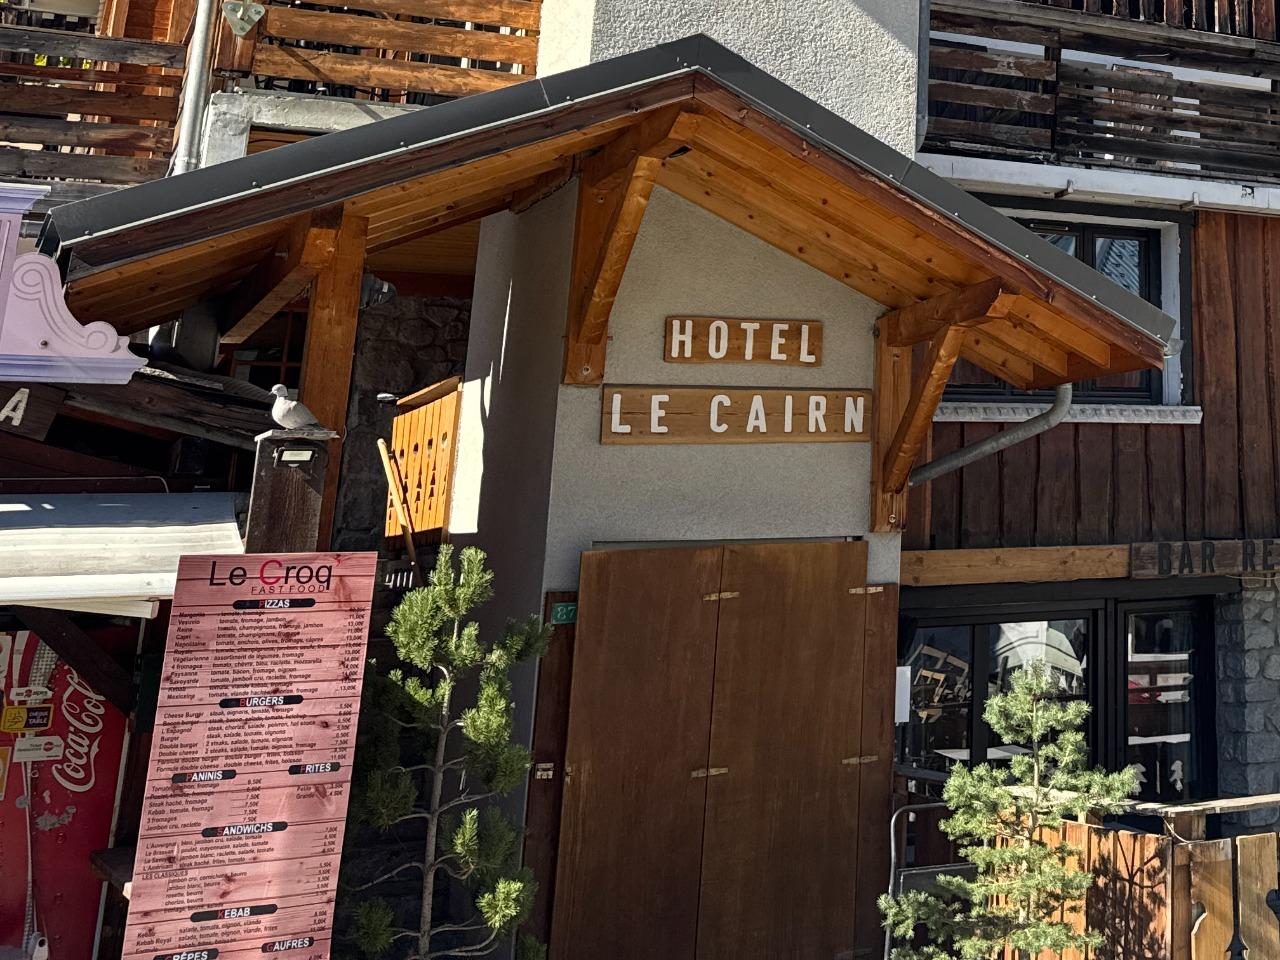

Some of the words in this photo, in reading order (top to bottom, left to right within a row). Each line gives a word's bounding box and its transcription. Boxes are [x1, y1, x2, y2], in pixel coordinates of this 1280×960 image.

[671, 320, 816, 363] HOTEL
[611, 393, 669, 433] LE
[709, 394, 864, 433] CAIRN
[1157, 541, 1215, 576] BAR
[209, 561, 247, 586] Le
[251, 585, 283, 594] FAST
[289, 584, 325, 593] FOOD
[260, 600, 290, 609] PIZZAS
[240, 696, 284, 707] BURGERS
[52, 664, 106, 792] Coca-Col
[300, 763, 331, 773] FRITES
[186, 771, 222, 781] PANINIS
[217, 822, 273, 836] SANDWICHS
[153, 870, 188, 879] CLASSIQUES
[217, 907, 251, 919] KEBAB
[266, 937, 310, 951] GAUFRES
